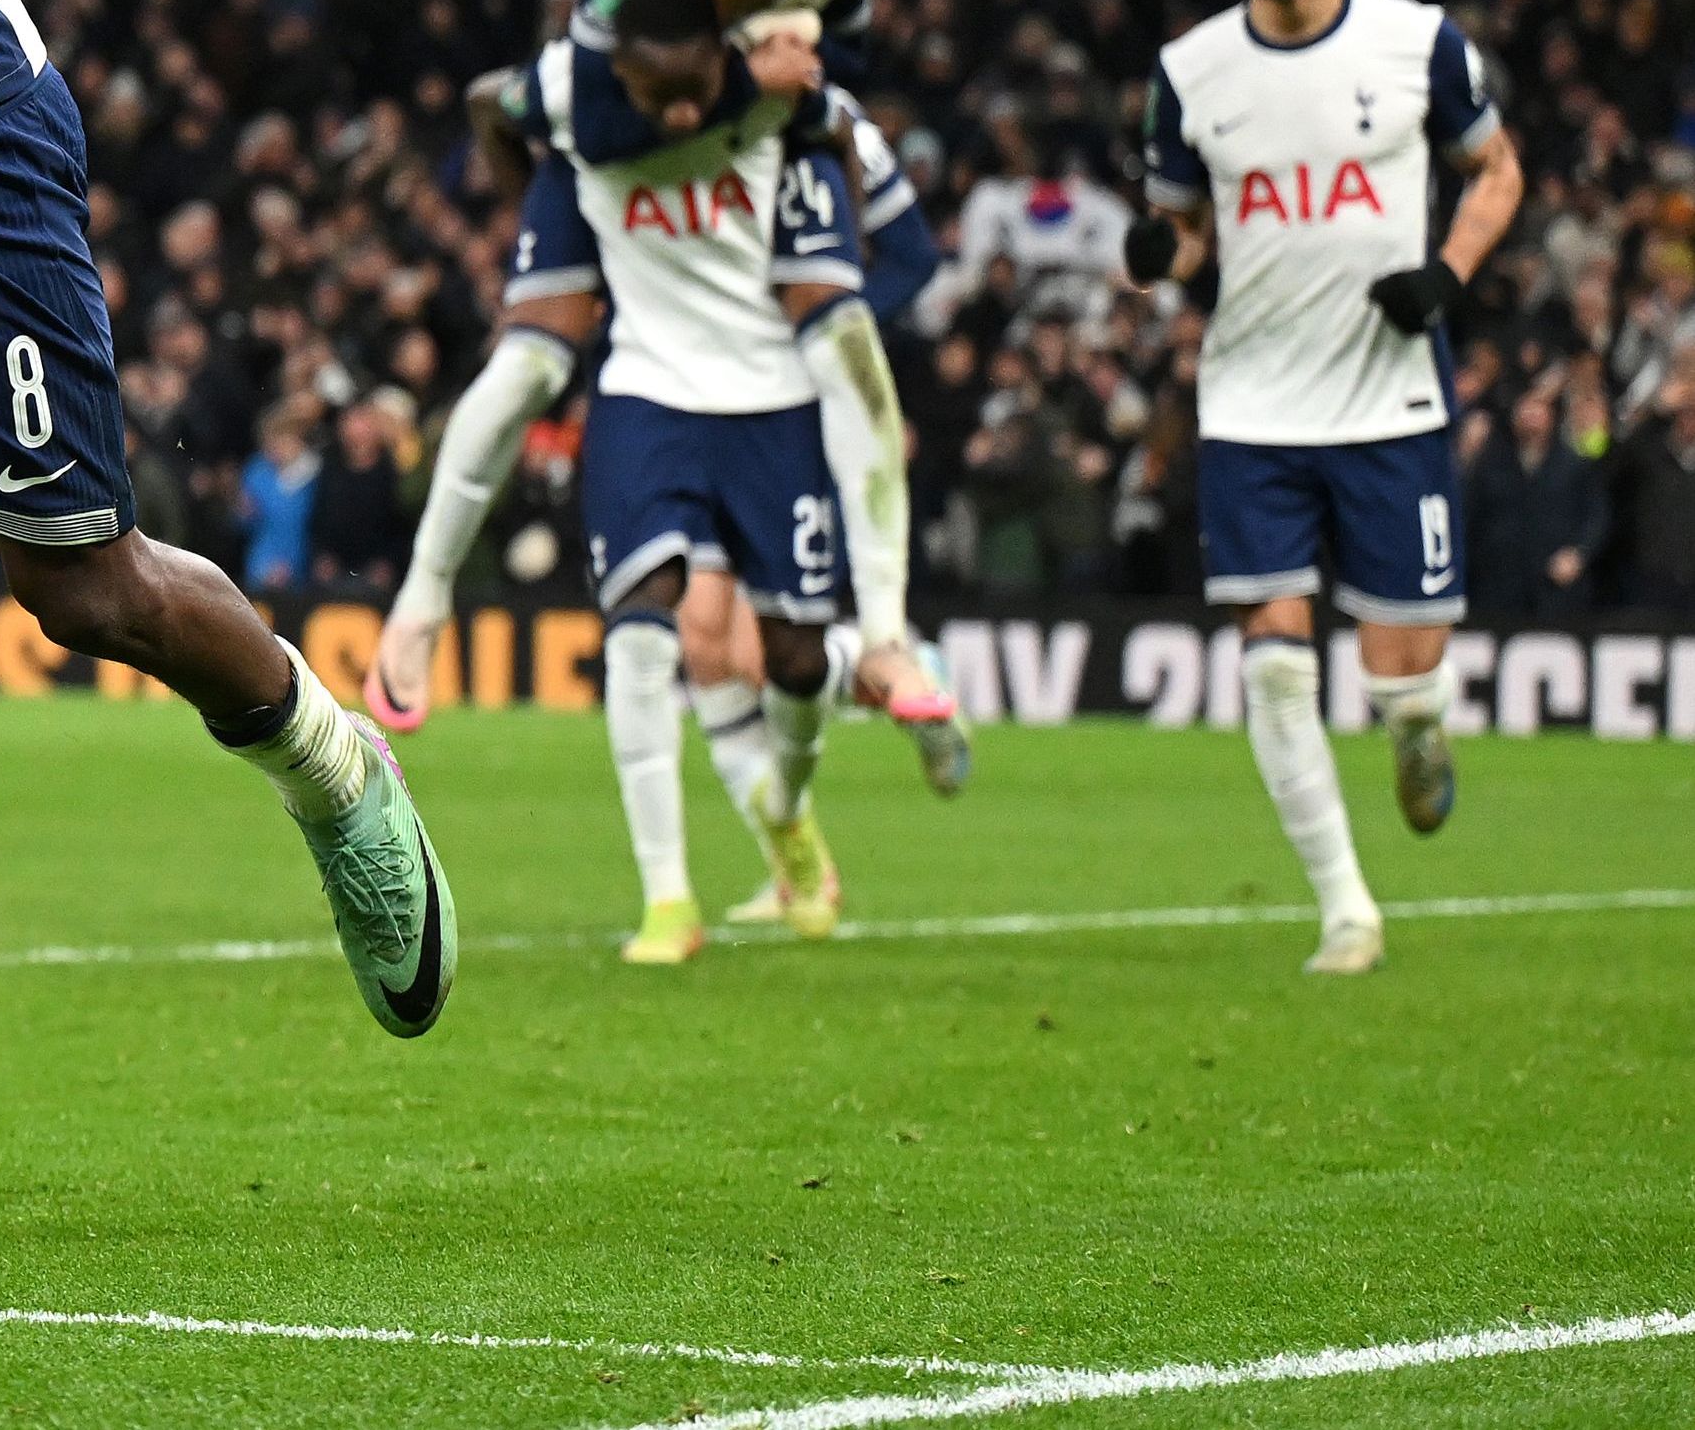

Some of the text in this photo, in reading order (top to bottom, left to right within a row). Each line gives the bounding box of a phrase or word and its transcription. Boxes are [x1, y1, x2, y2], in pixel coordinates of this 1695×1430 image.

[625, 168, 756, 237] AIA
[779, 159, 835, 229] 24
[1238, 158, 1386, 223] AIA
[6, 334, 53, 449] 8
